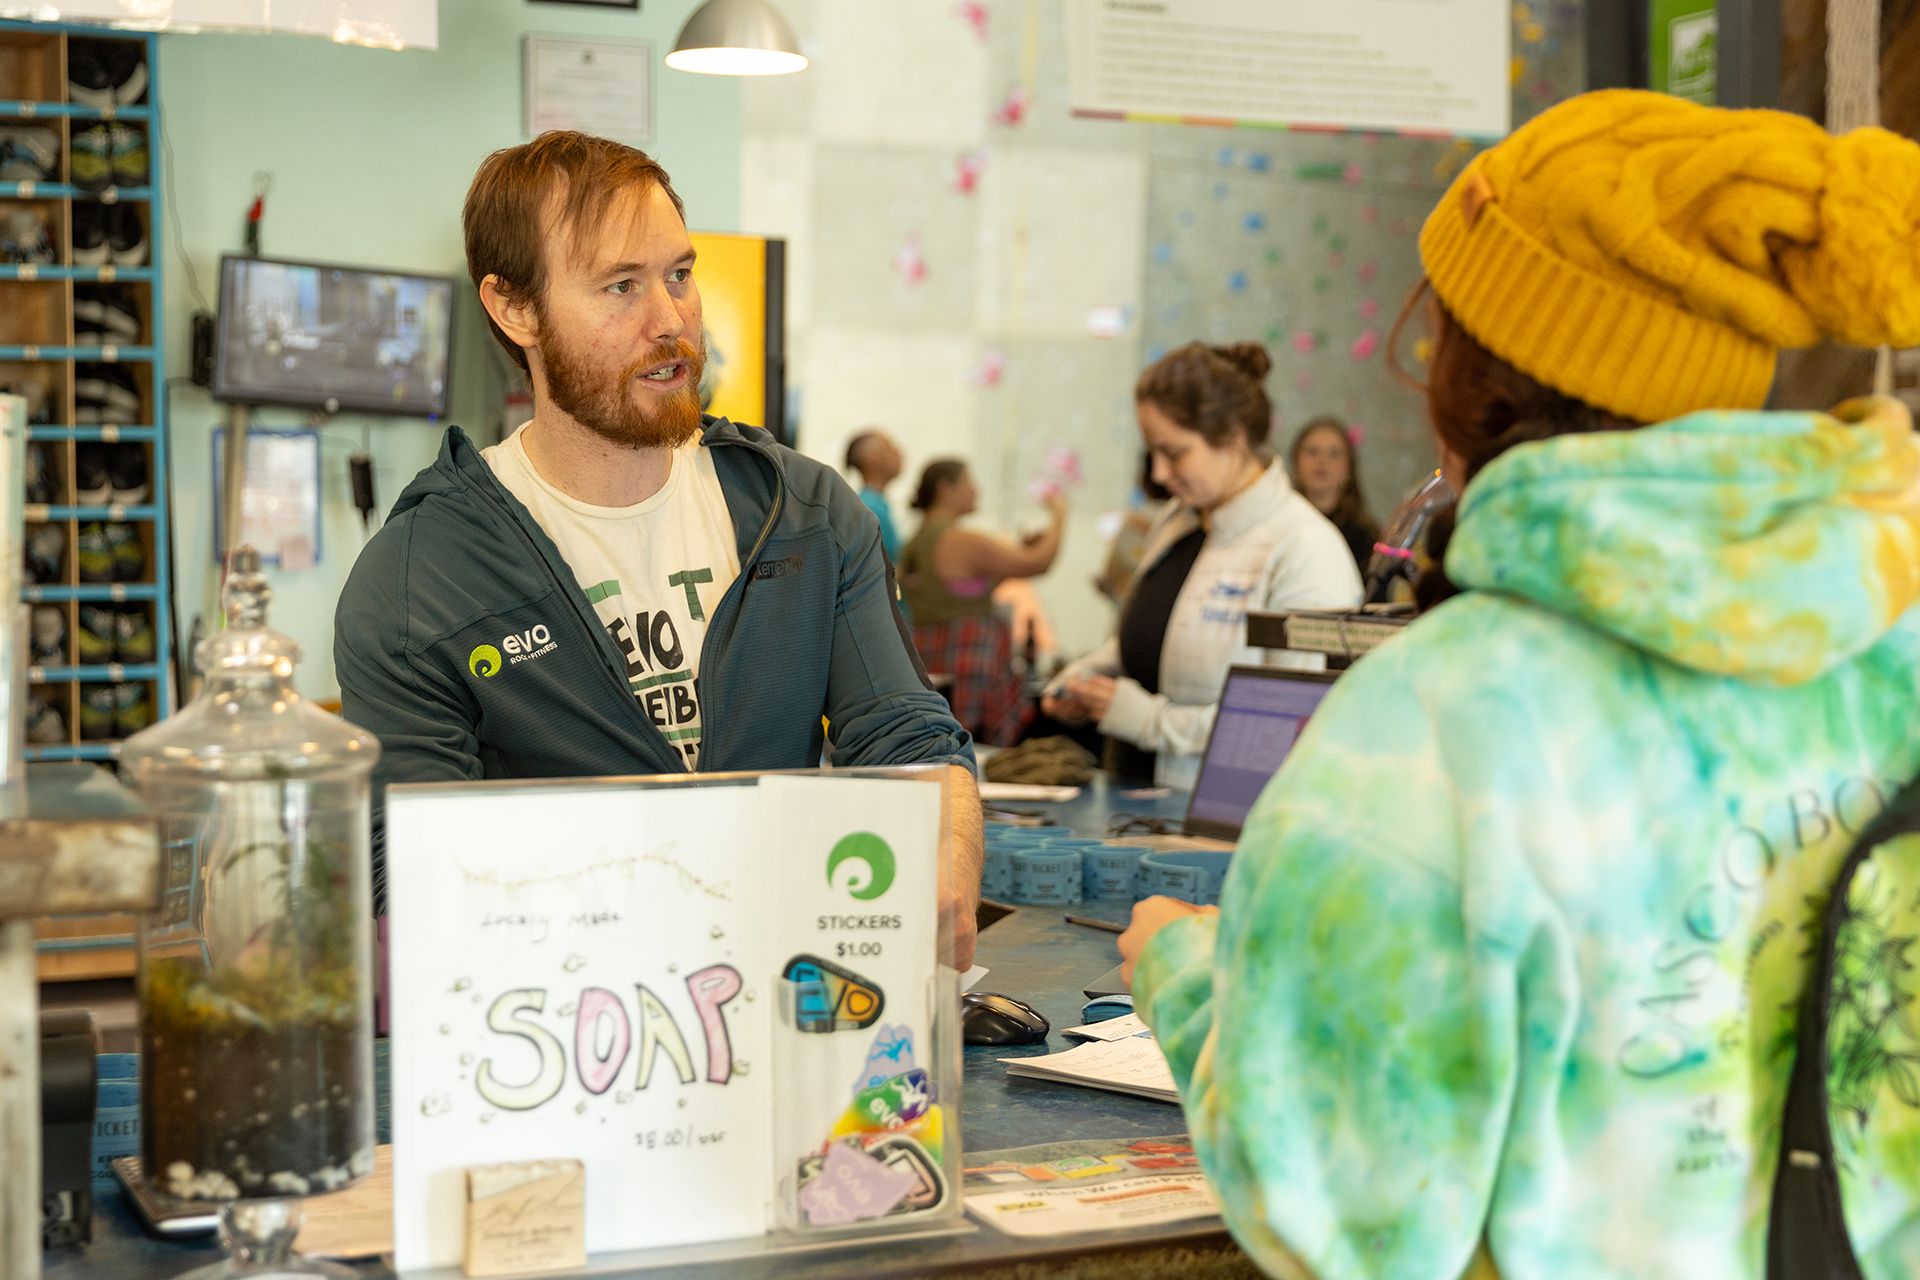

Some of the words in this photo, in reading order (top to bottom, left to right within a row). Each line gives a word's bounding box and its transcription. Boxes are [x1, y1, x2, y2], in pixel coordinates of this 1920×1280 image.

[502, 624, 551, 654] evo
[1032, 863, 1061, 874] TICKET
[817, 914, 902, 930] STICKERS
[836, 941, 882, 957] $1.00
[475, 963, 743, 1111] SOAP
[93, 1119, 138, 1136] ICKET
